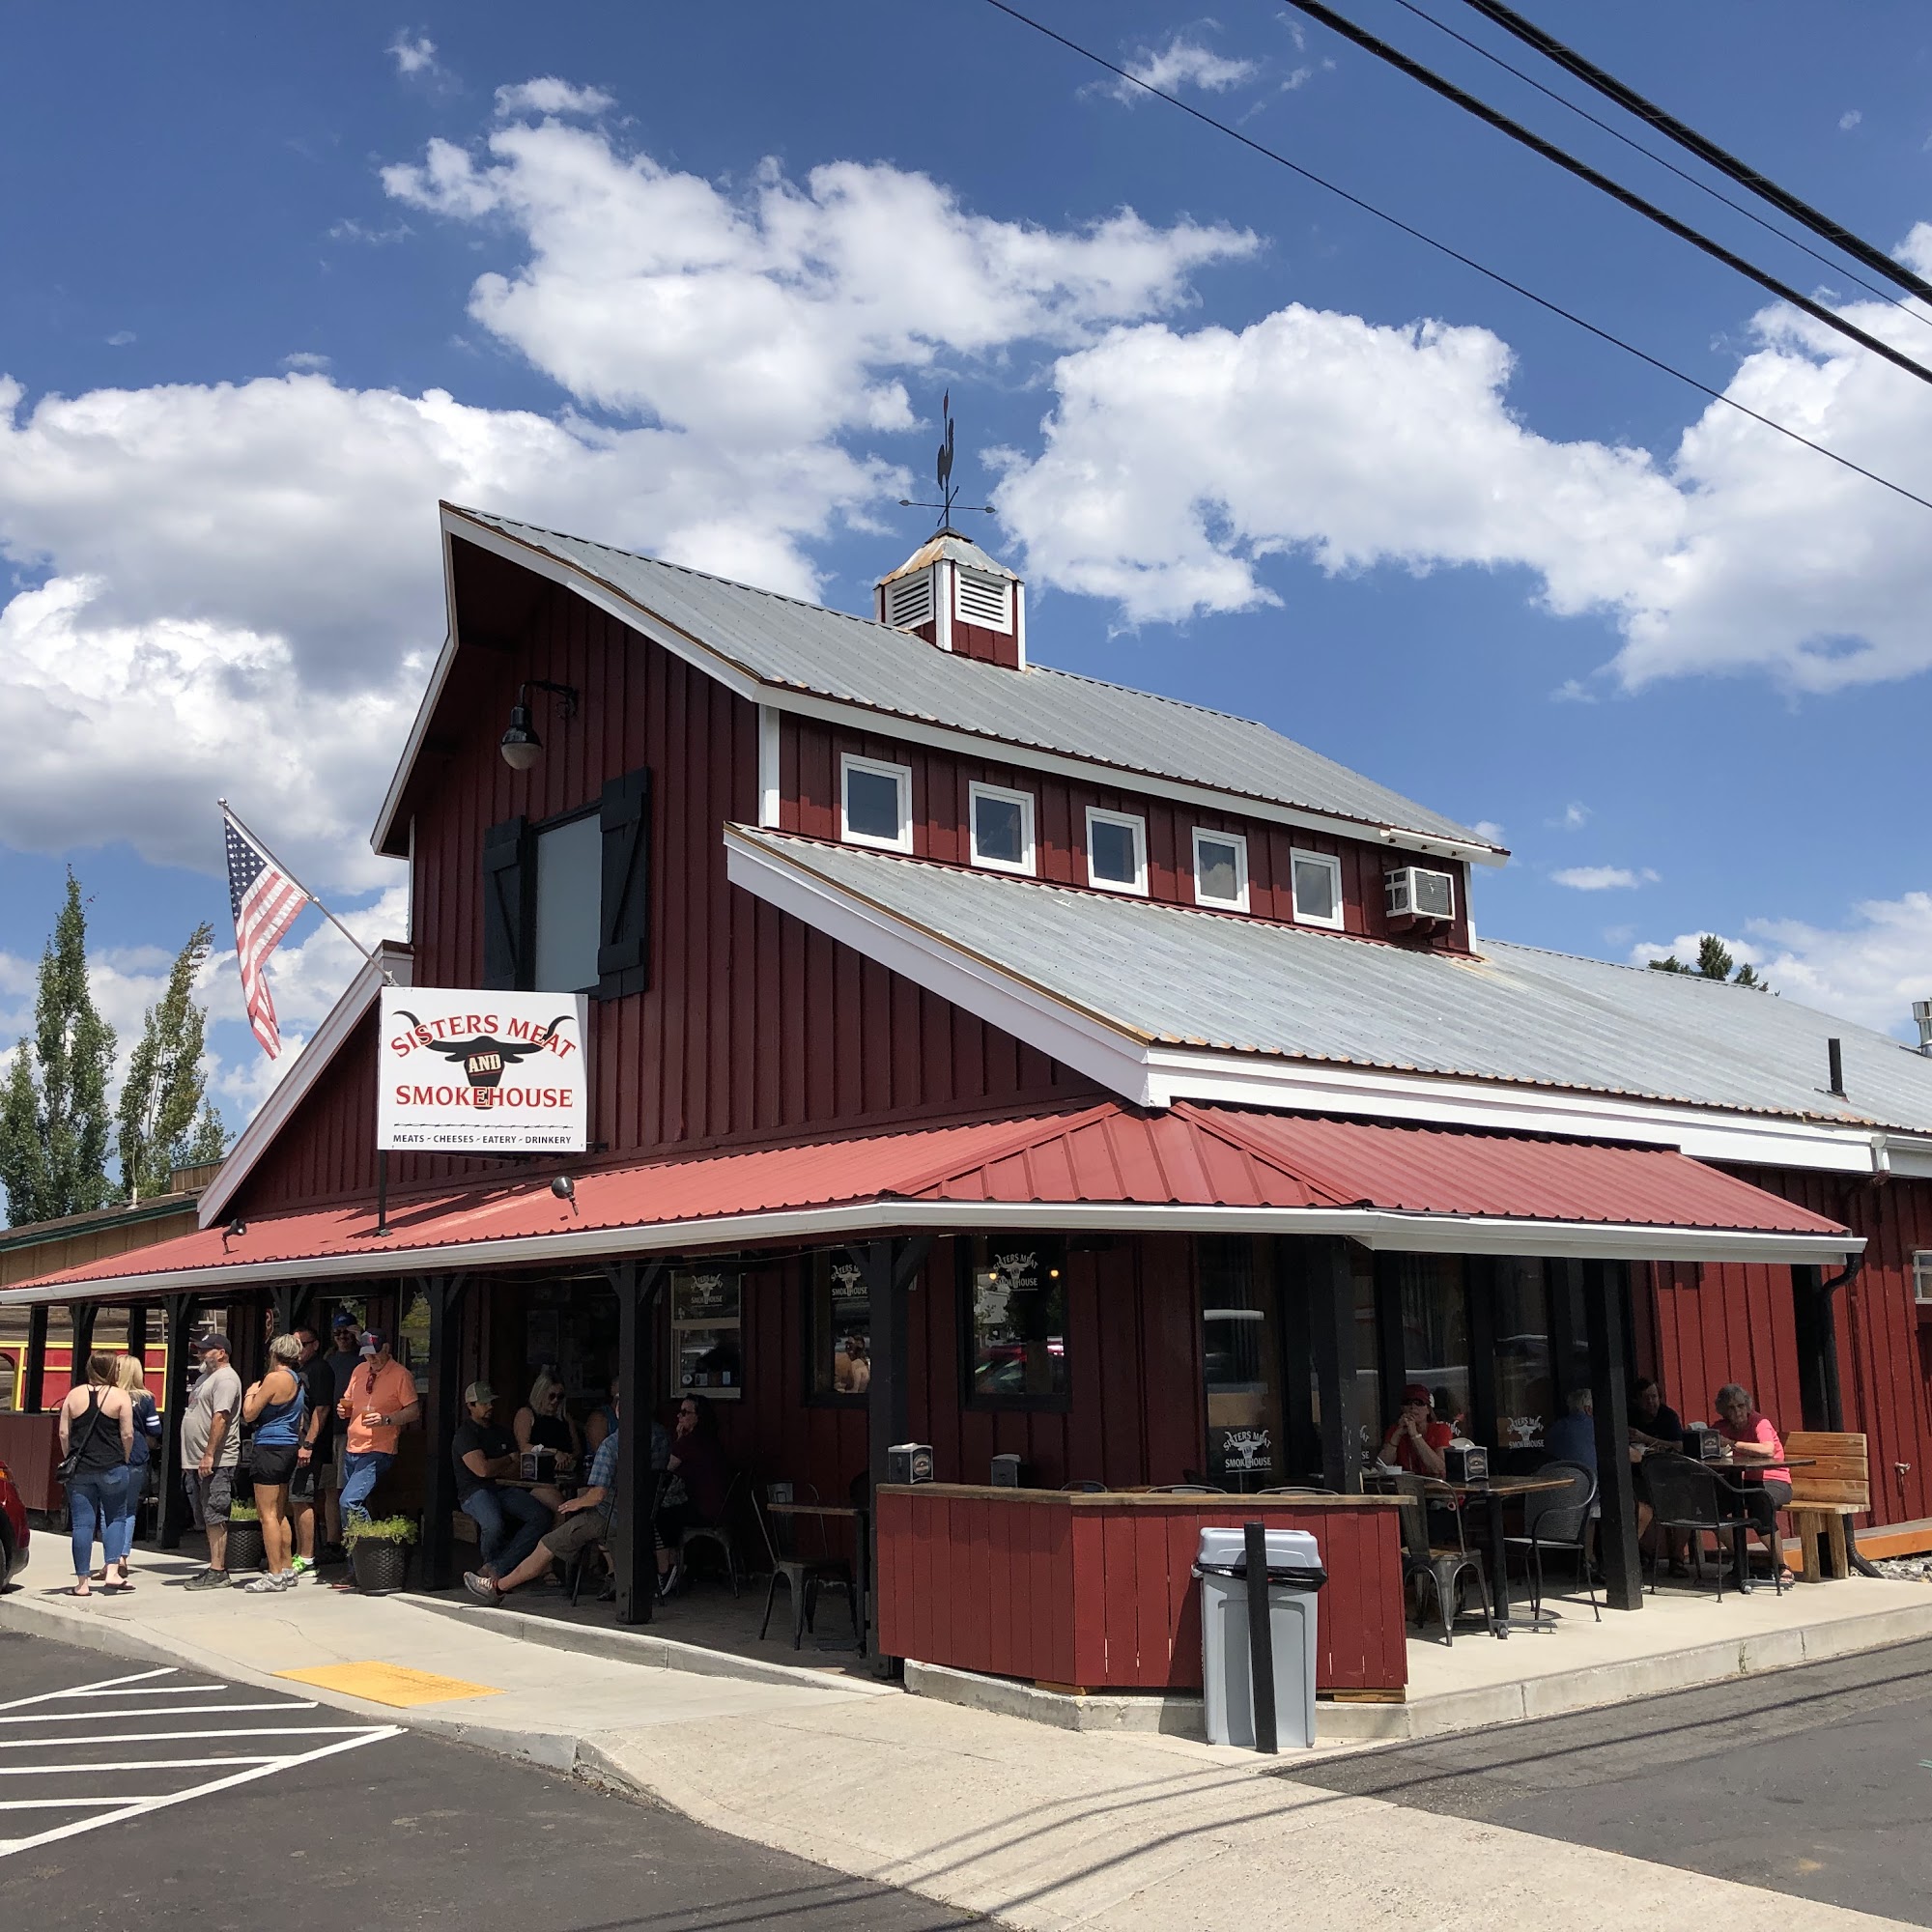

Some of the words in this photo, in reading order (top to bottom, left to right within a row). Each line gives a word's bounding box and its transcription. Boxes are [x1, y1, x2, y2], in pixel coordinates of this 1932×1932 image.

[391, 1014, 499, 1058] SISTERS
[506, 1017, 577, 1060] MEAT
[469, 1054, 501, 1073] AND
[395, 1086, 574, 1108] SMOKEHOUSE
[393, 1134, 425, 1143] MEATS
[483, 1135, 517, 1144] EATERY
